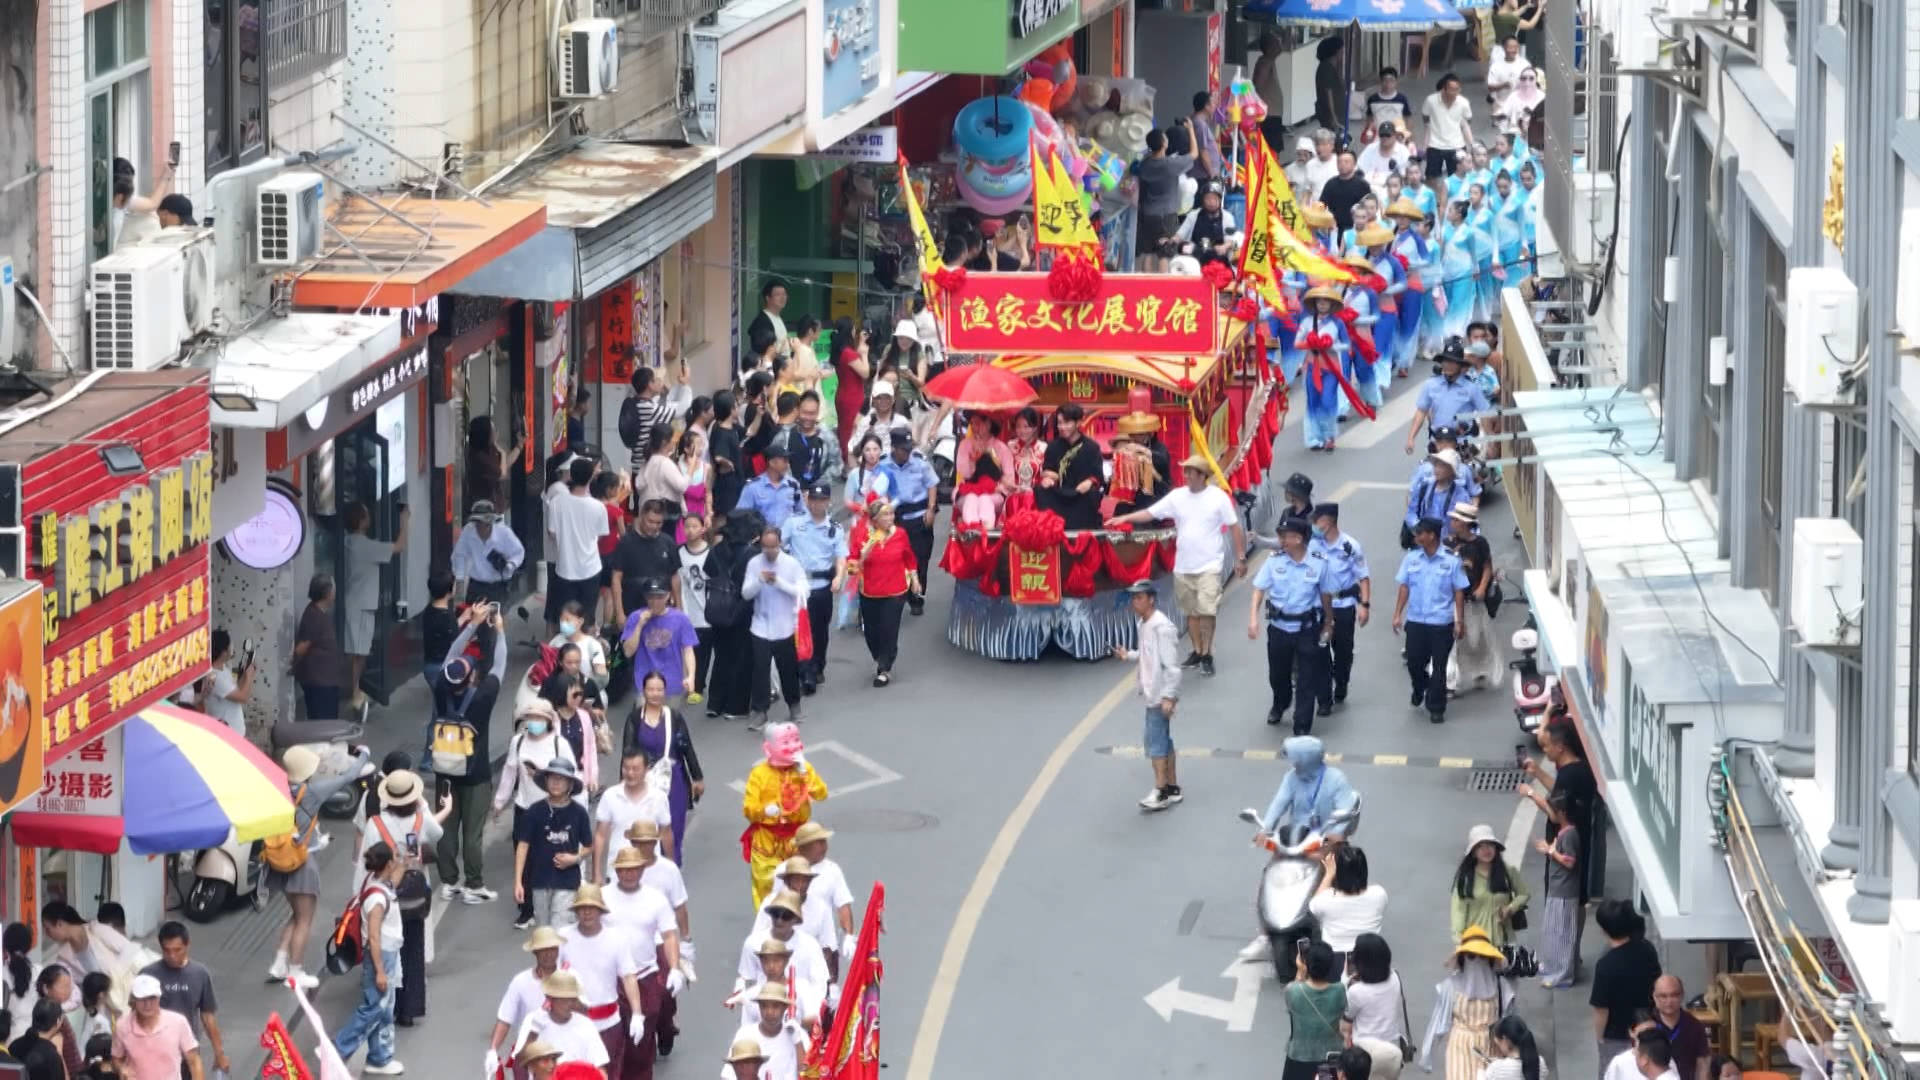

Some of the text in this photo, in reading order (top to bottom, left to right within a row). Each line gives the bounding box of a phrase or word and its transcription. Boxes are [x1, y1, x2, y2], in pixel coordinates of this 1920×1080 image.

[960, 293, 1202, 336] 渔家文化展览馆
